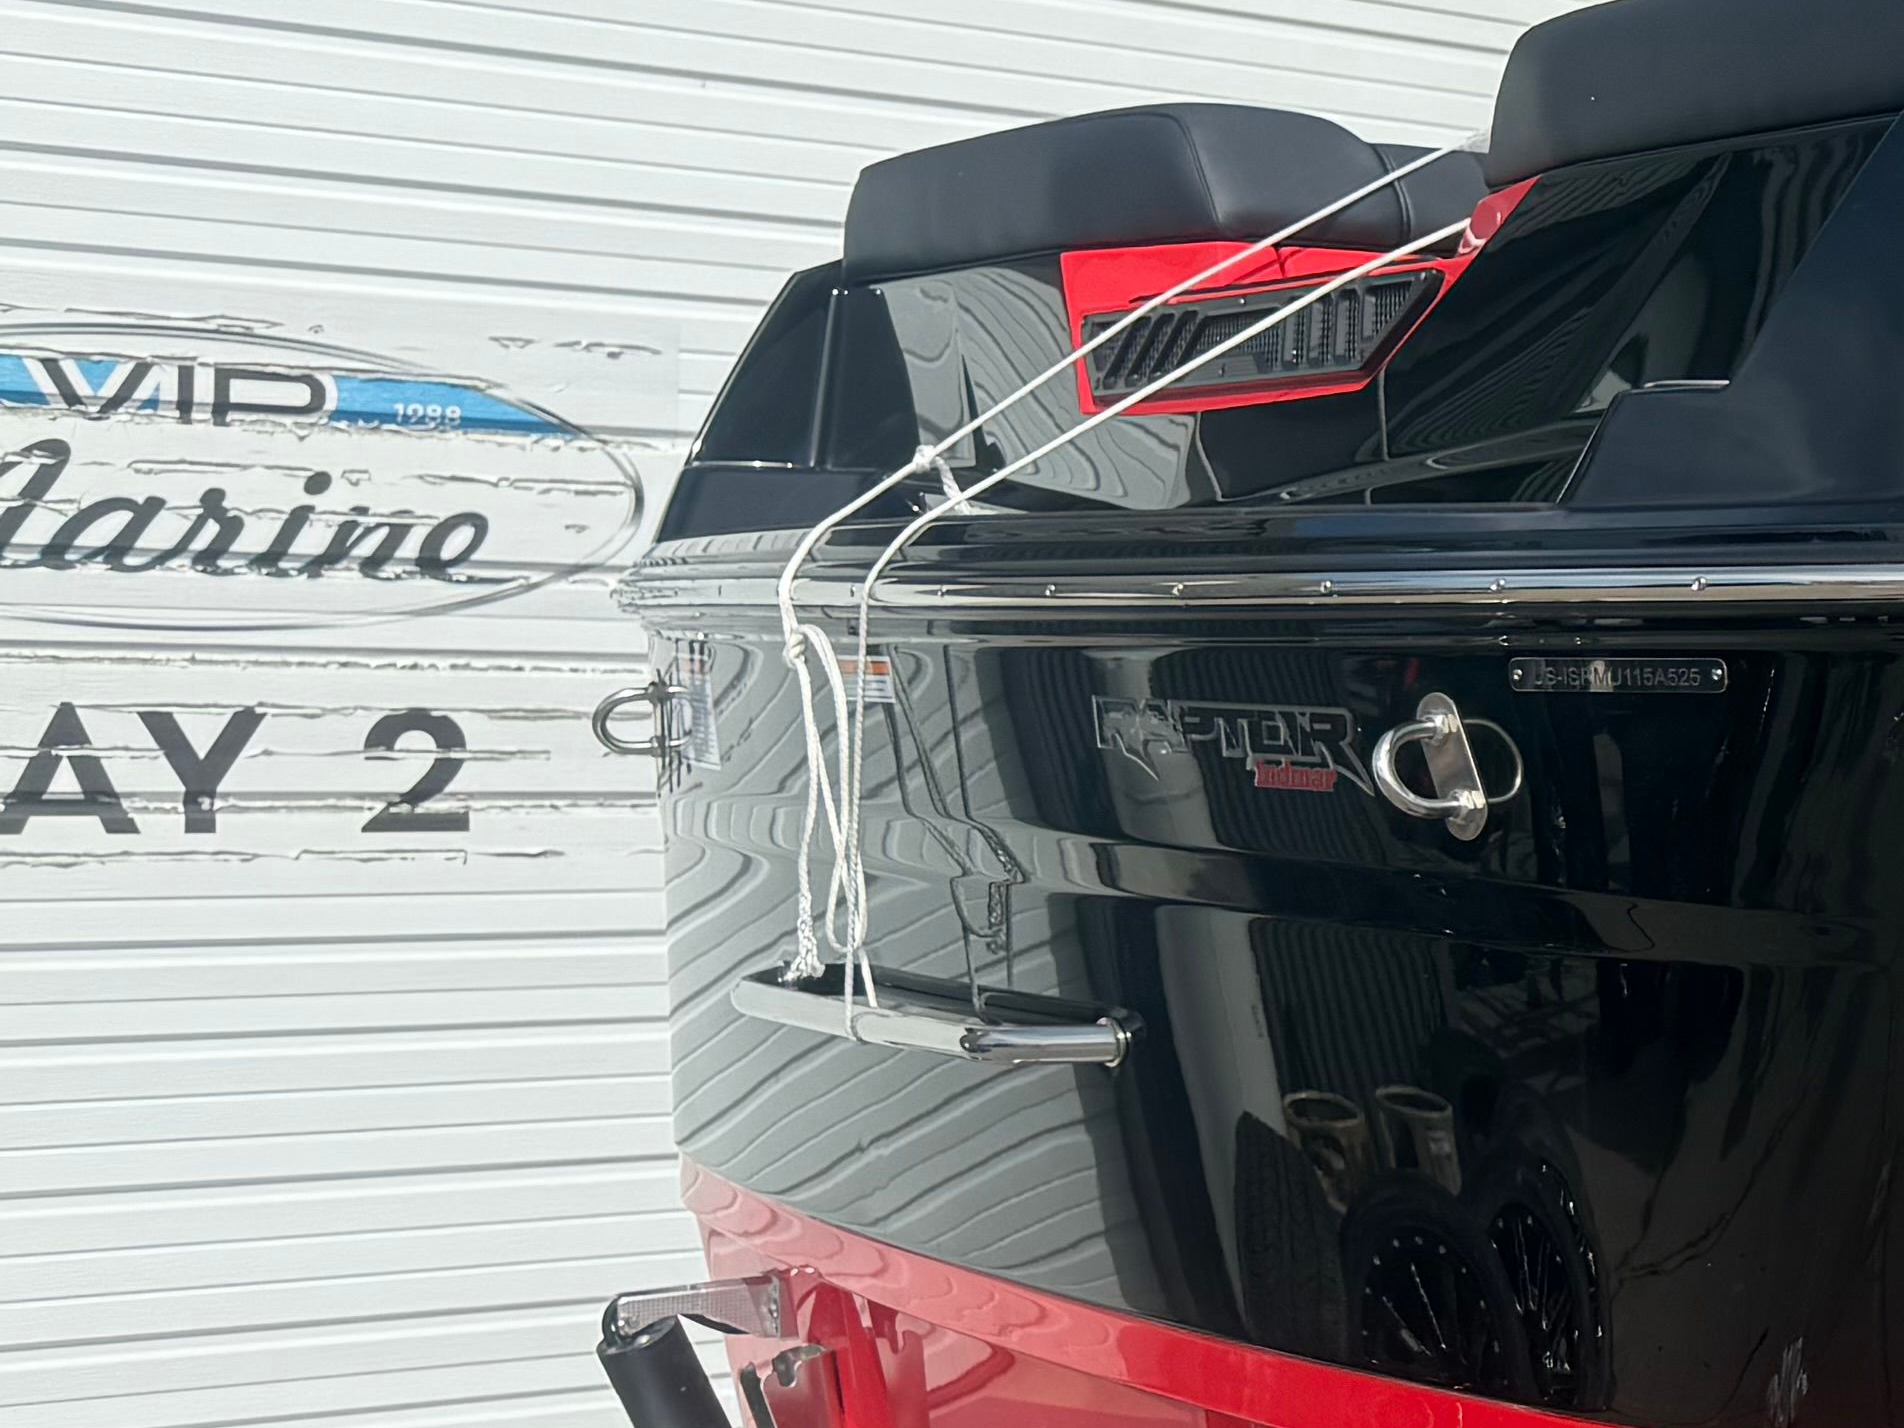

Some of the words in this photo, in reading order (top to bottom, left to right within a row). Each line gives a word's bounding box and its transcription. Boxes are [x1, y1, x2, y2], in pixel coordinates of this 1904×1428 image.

[38, 357, 328, 427] VIP
[361, 707, 470, 834] 2
[1092, 694, 1375, 797] RAPTOR
